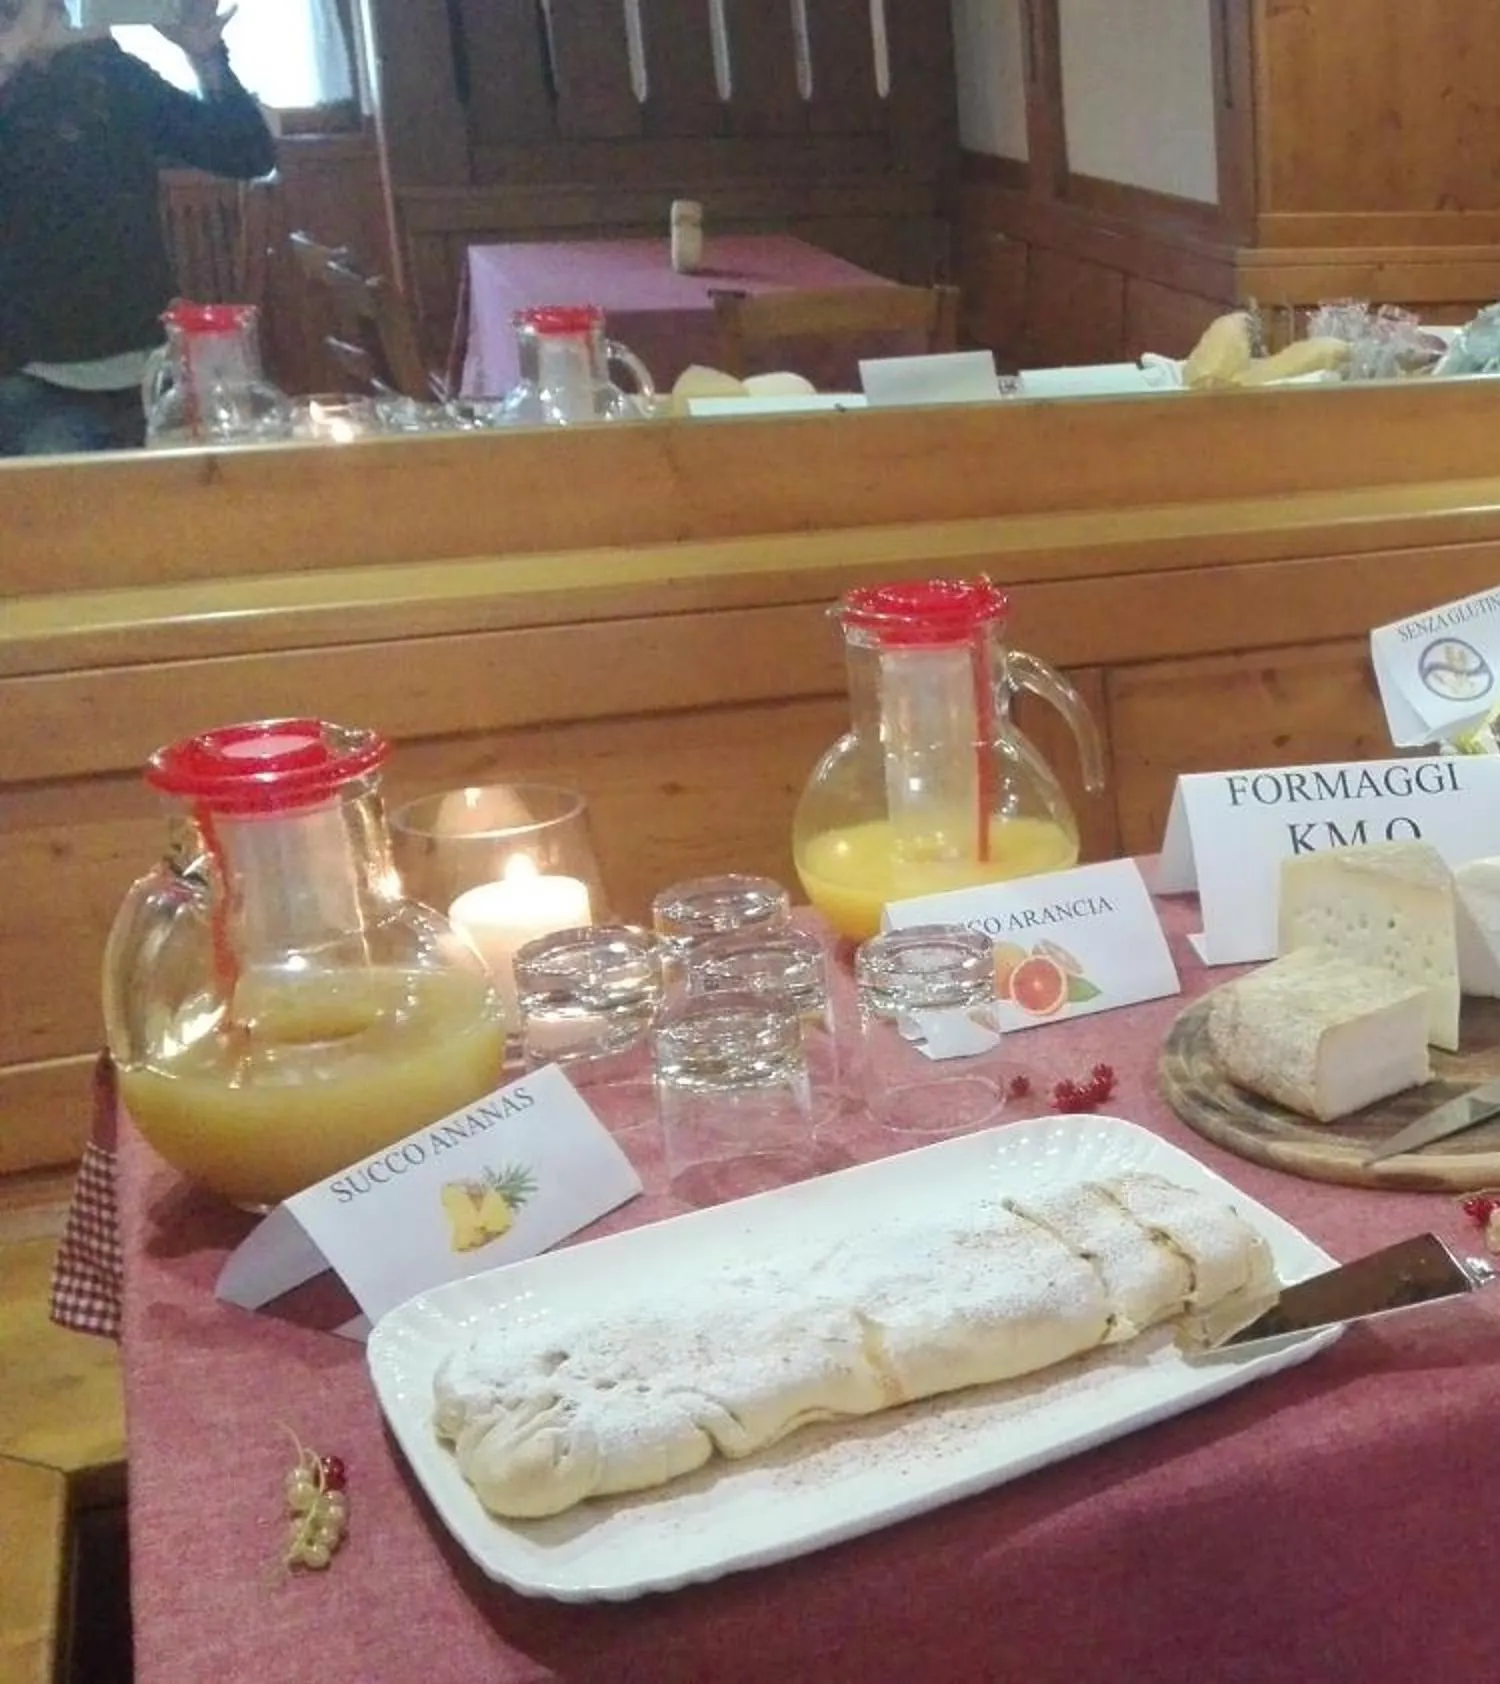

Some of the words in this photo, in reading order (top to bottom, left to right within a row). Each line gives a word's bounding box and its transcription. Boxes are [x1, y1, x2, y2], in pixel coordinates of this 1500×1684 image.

[1396, 614, 1449, 642] SENZA
[1226, 762, 1464, 806] FORMAGGI
[1008, 895, 1115, 931] ARANCIA
[329, 1142, 425, 1205] SUCCO
[429, 1086, 536, 1156] ANANAS
